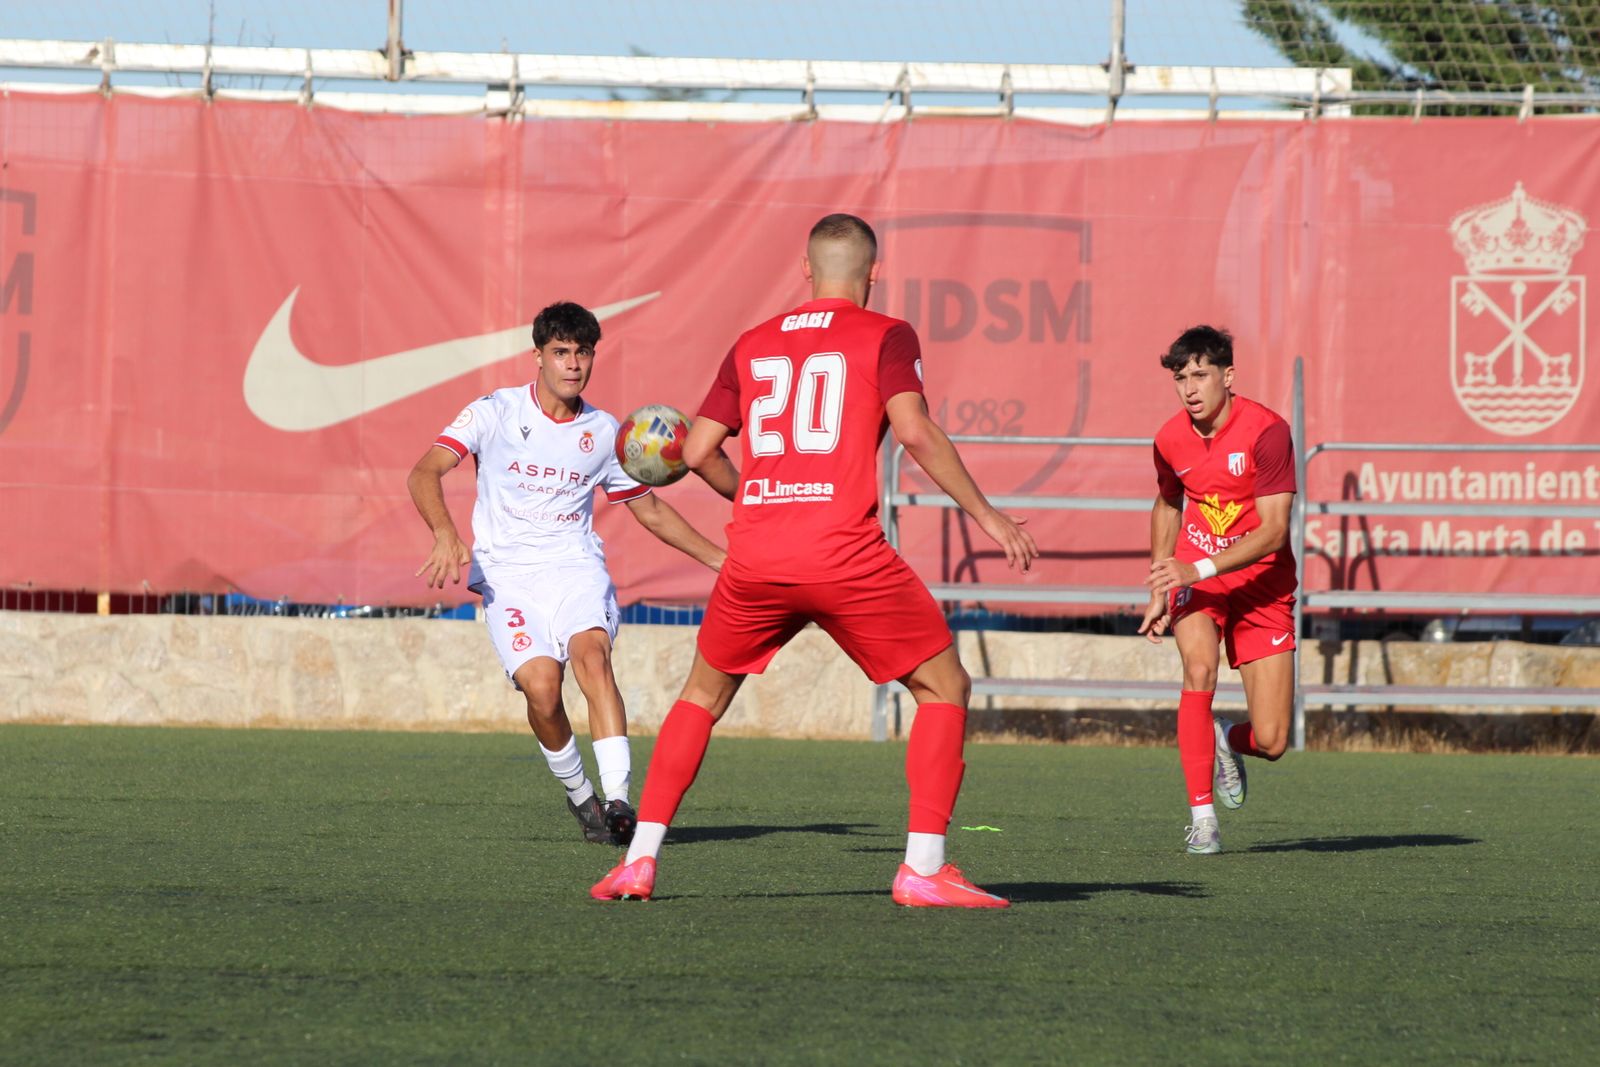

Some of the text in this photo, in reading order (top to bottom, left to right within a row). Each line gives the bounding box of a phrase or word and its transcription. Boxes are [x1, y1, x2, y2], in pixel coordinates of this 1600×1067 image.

[780, 311, 835, 332] GABI
[748, 351, 847, 458] 20
[936, 397, 1027, 436] 1982
[517, 481, 578, 498] ACADEMY
[762, 478, 834, 497] Limcasa
[1304, 519, 1587, 558] Santa Marta de
[505, 607, 525, 628] 3
